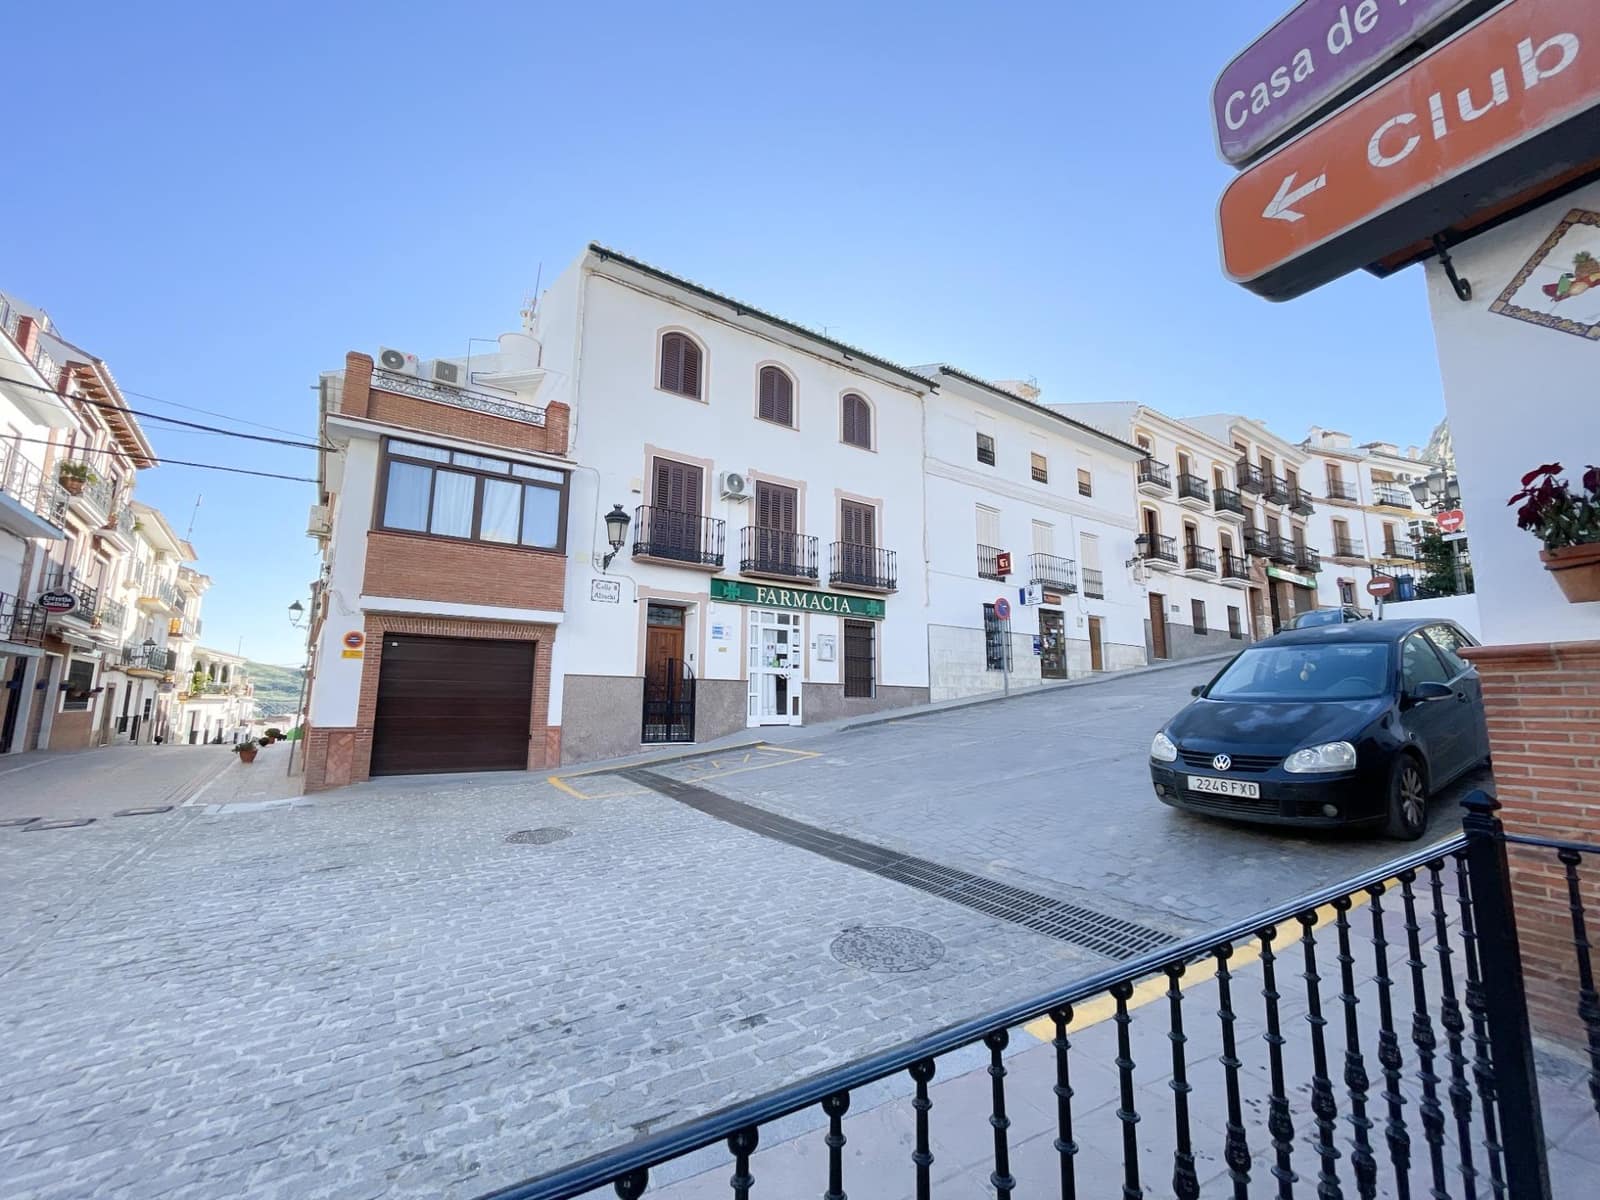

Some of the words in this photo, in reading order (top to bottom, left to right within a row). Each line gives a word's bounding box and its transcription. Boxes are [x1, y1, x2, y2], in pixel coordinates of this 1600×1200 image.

[1224, 47, 1316, 131] Casa
[1326, 0, 1380, 55] de
[1367, 32, 1580, 168] Club
[756, 586, 851, 613] FARMACIA
[1196, 779, 1228, 793] 2246
[1231, 782, 1257, 796] FXD
